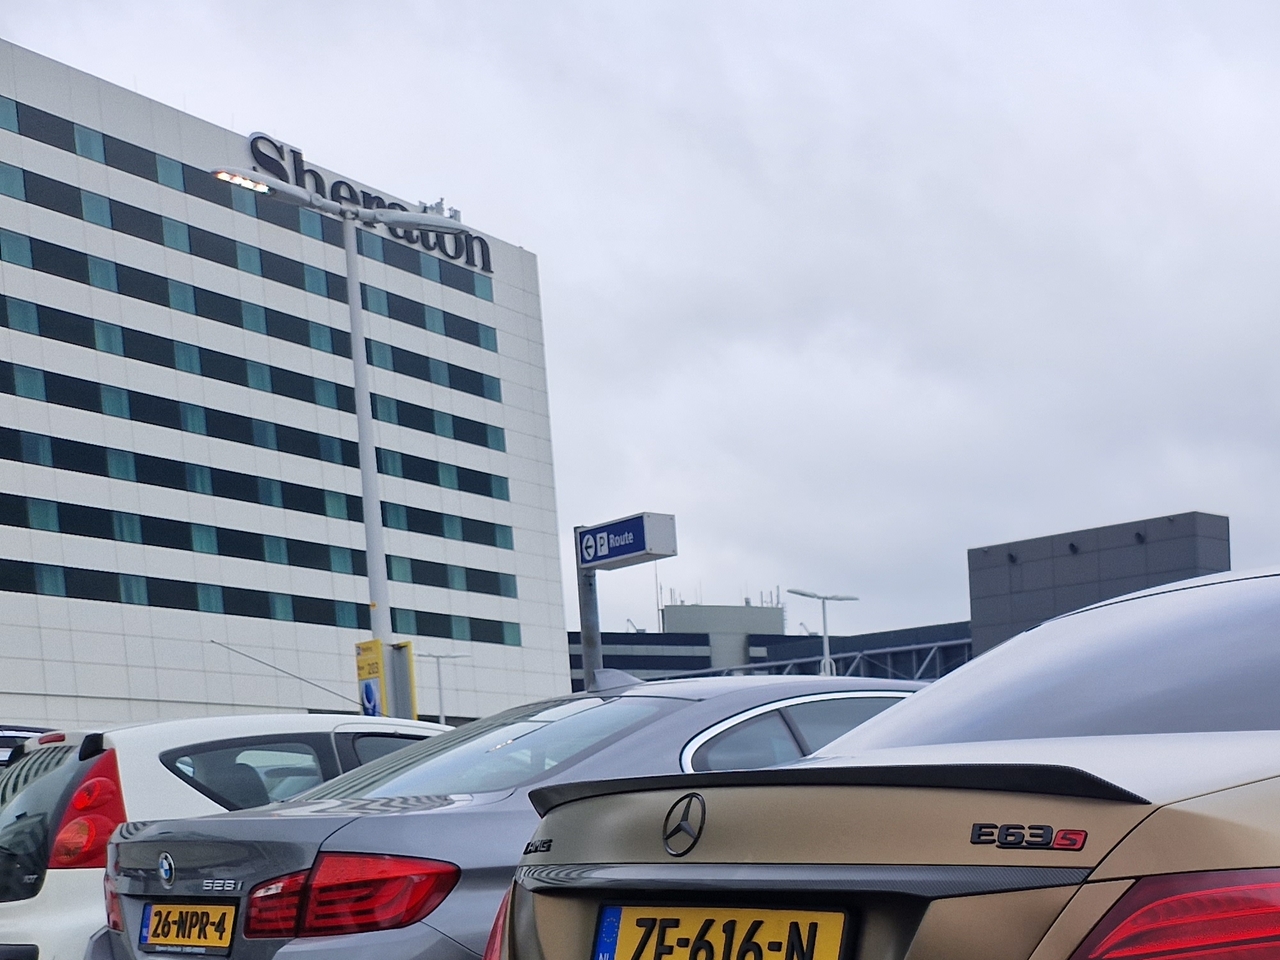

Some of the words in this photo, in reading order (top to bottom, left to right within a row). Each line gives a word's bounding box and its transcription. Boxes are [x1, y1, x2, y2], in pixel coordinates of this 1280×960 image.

[249, 132, 494, 274] Sheraton
[609, 531, 634, 547] Route
[151, 910, 227, 940] 26-NPR-4
